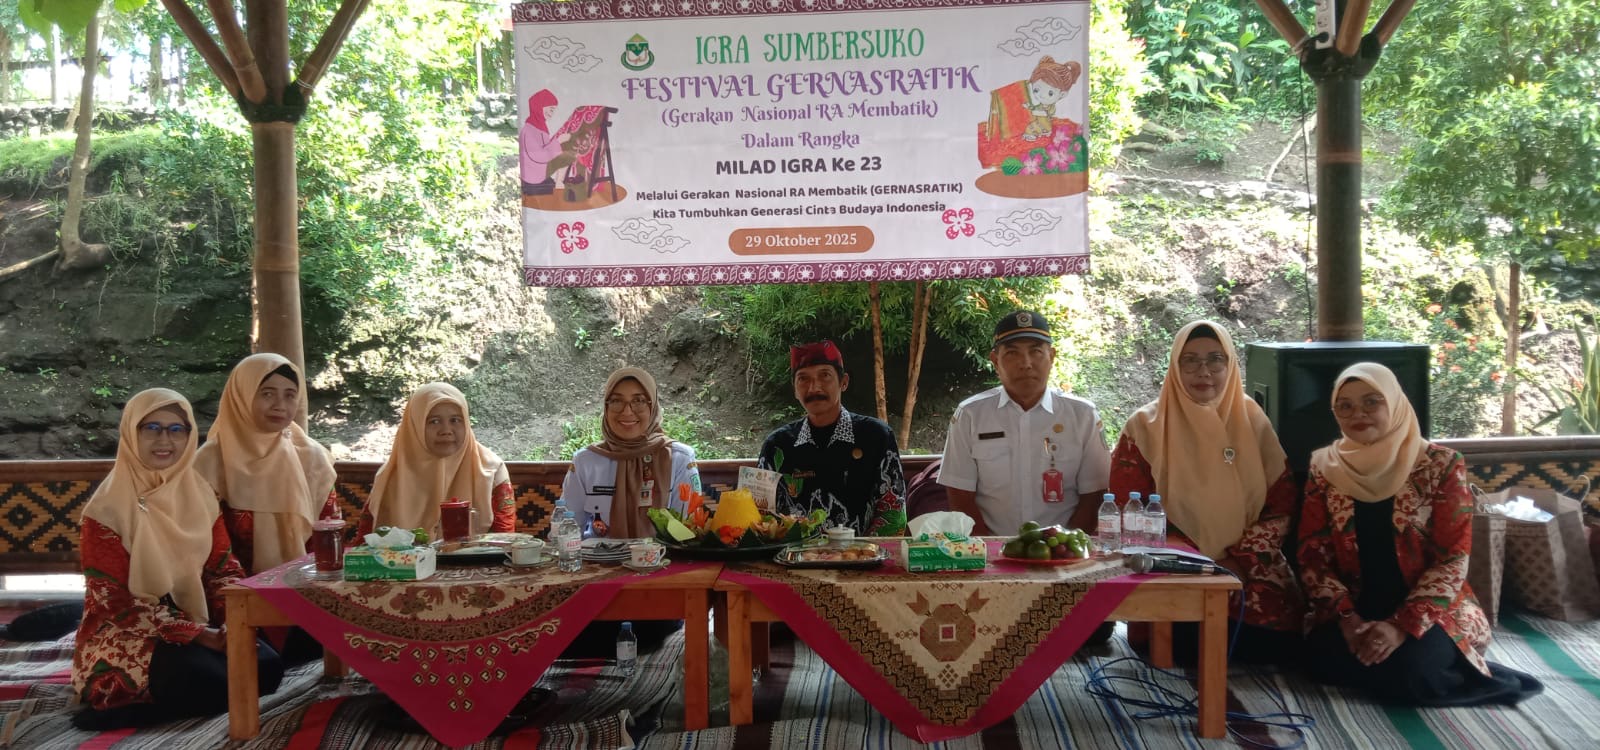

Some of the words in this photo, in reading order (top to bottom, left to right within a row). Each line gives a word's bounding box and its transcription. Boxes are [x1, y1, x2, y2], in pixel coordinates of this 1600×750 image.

[696, 35, 750, 64] IGRA
[763, 28, 925, 62] SUMBERSUKO
[621, 74, 761, 102] FESTIVAL
[767, 65, 982, 102] GERNASRATIK
[662, 107, 734, 128] (Gerakan
[741, 103, 811, 122] Nasional
[815, 103, 843, 121] RA
[848, 100, 938, 118] Membatik)
[741, 132, 794, 149] Dalam
[798, 130, 860, 149] Rangka
[716, 159, 776, 175] MILAD
[781, 158, 827, 174] IGRA
[832, 157, 856, 172] Ke
[860, 156, 882, 171] 23
[636, 190, 678, 201] Melalui
[681, 190, 730, 200] Gerakan
[735, 187, 786, 199] Nasional
[789, 187, 806, 197] RA
[808, 185, 868, 196] Membatik
[870, 182, 963, 196] (GERNASRATIK)
[653, 208, 676, 219] Kita
[678, 206, 748, 218] Tumbuhkan
[751, 205, 803, 216] Generasi
[839, 203, 884, 216] Budaya
[886, 201, 946, 213] Indonesia
[745, 235, 761, 248] 29
[765, 234, 821, 247] Oktober
[825, 233, 857, 246] 2025
